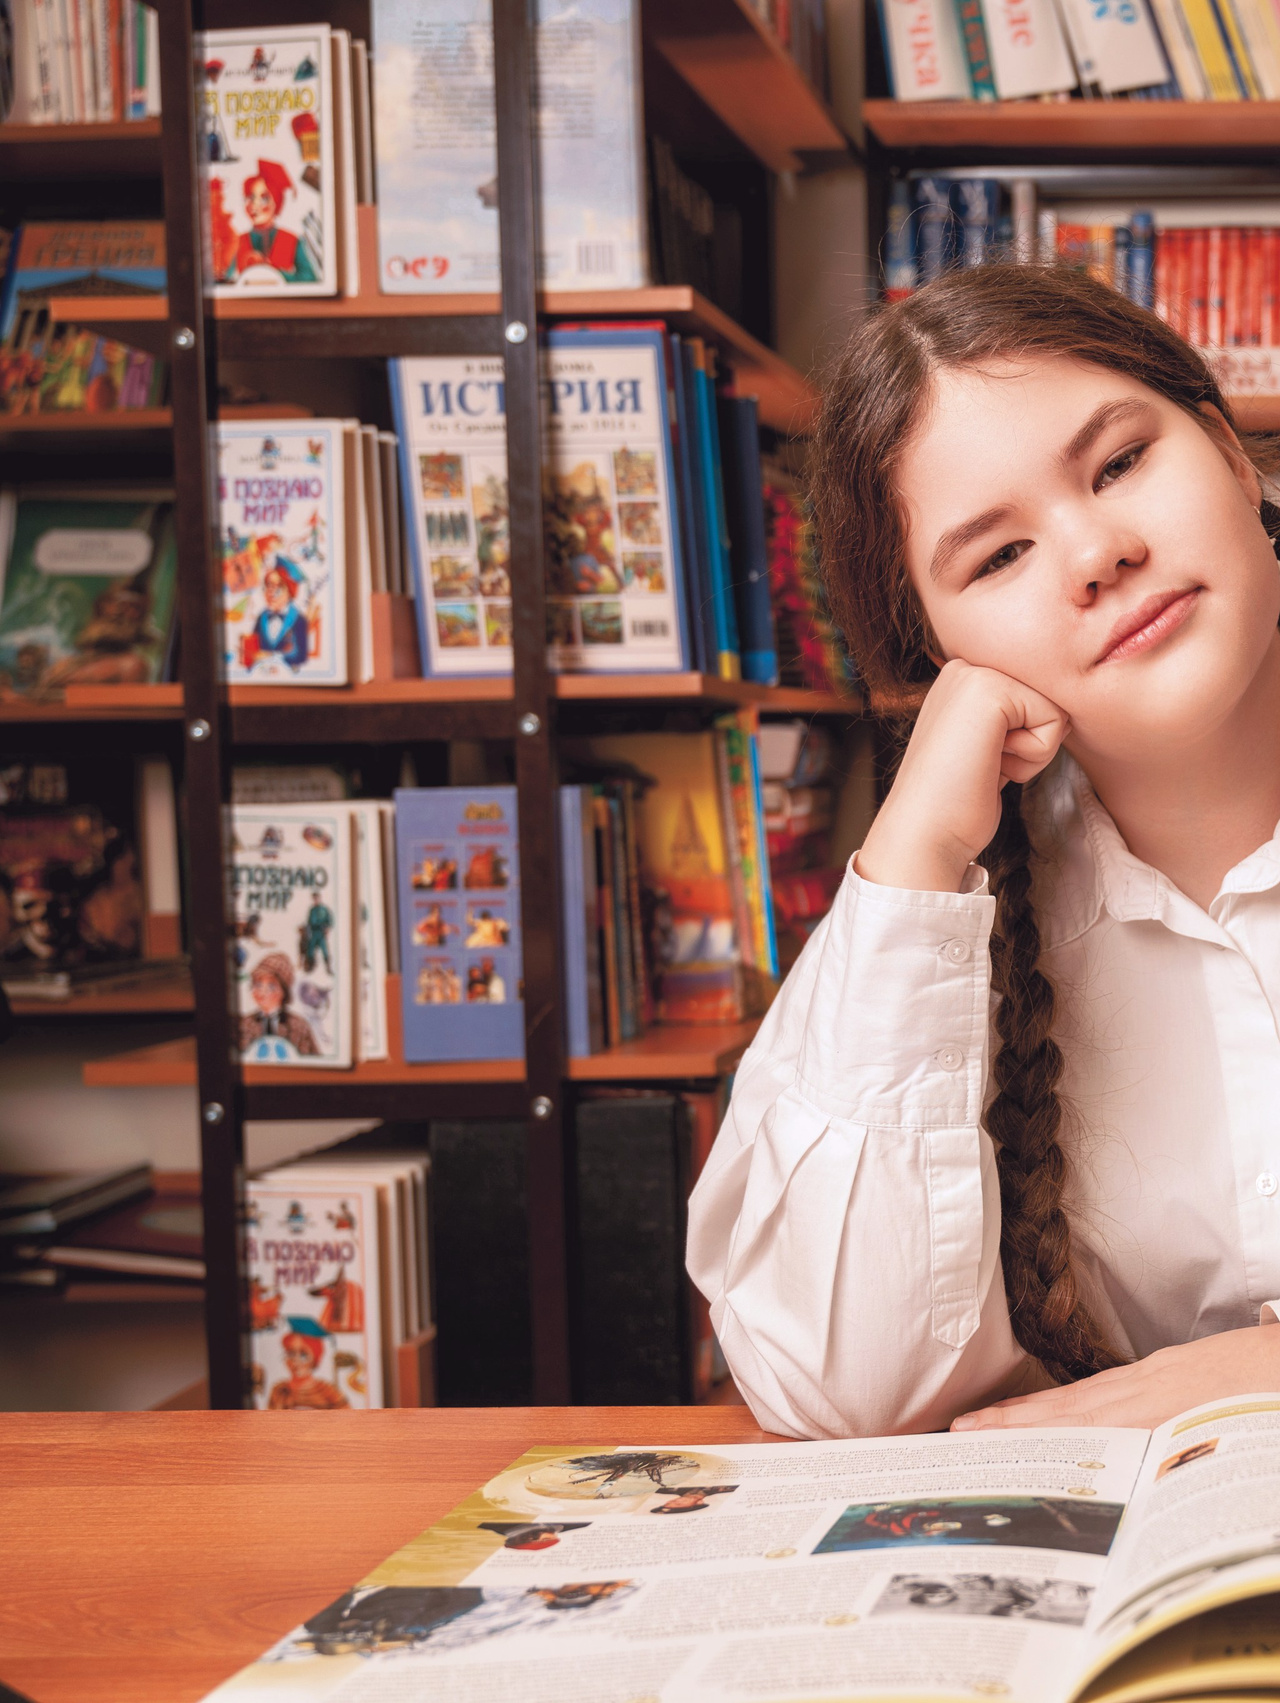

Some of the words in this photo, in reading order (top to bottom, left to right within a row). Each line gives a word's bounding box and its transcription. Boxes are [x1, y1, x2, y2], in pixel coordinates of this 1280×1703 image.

[225, 86, 316, 115] ПОЗНАЮ
[235, 114, 281, 138] МИР
[419, 378, 643, 417] ИСТРИЯ
[234, 478, 323, 500] ПОЗНАЮ
[244, 502, 290, 524] МИР
[246, 889, 293, 911] МИР
[264, 1240, 355, 1263] ПОЗНАЮ
[275, 1264, 320, 1288] МИР
